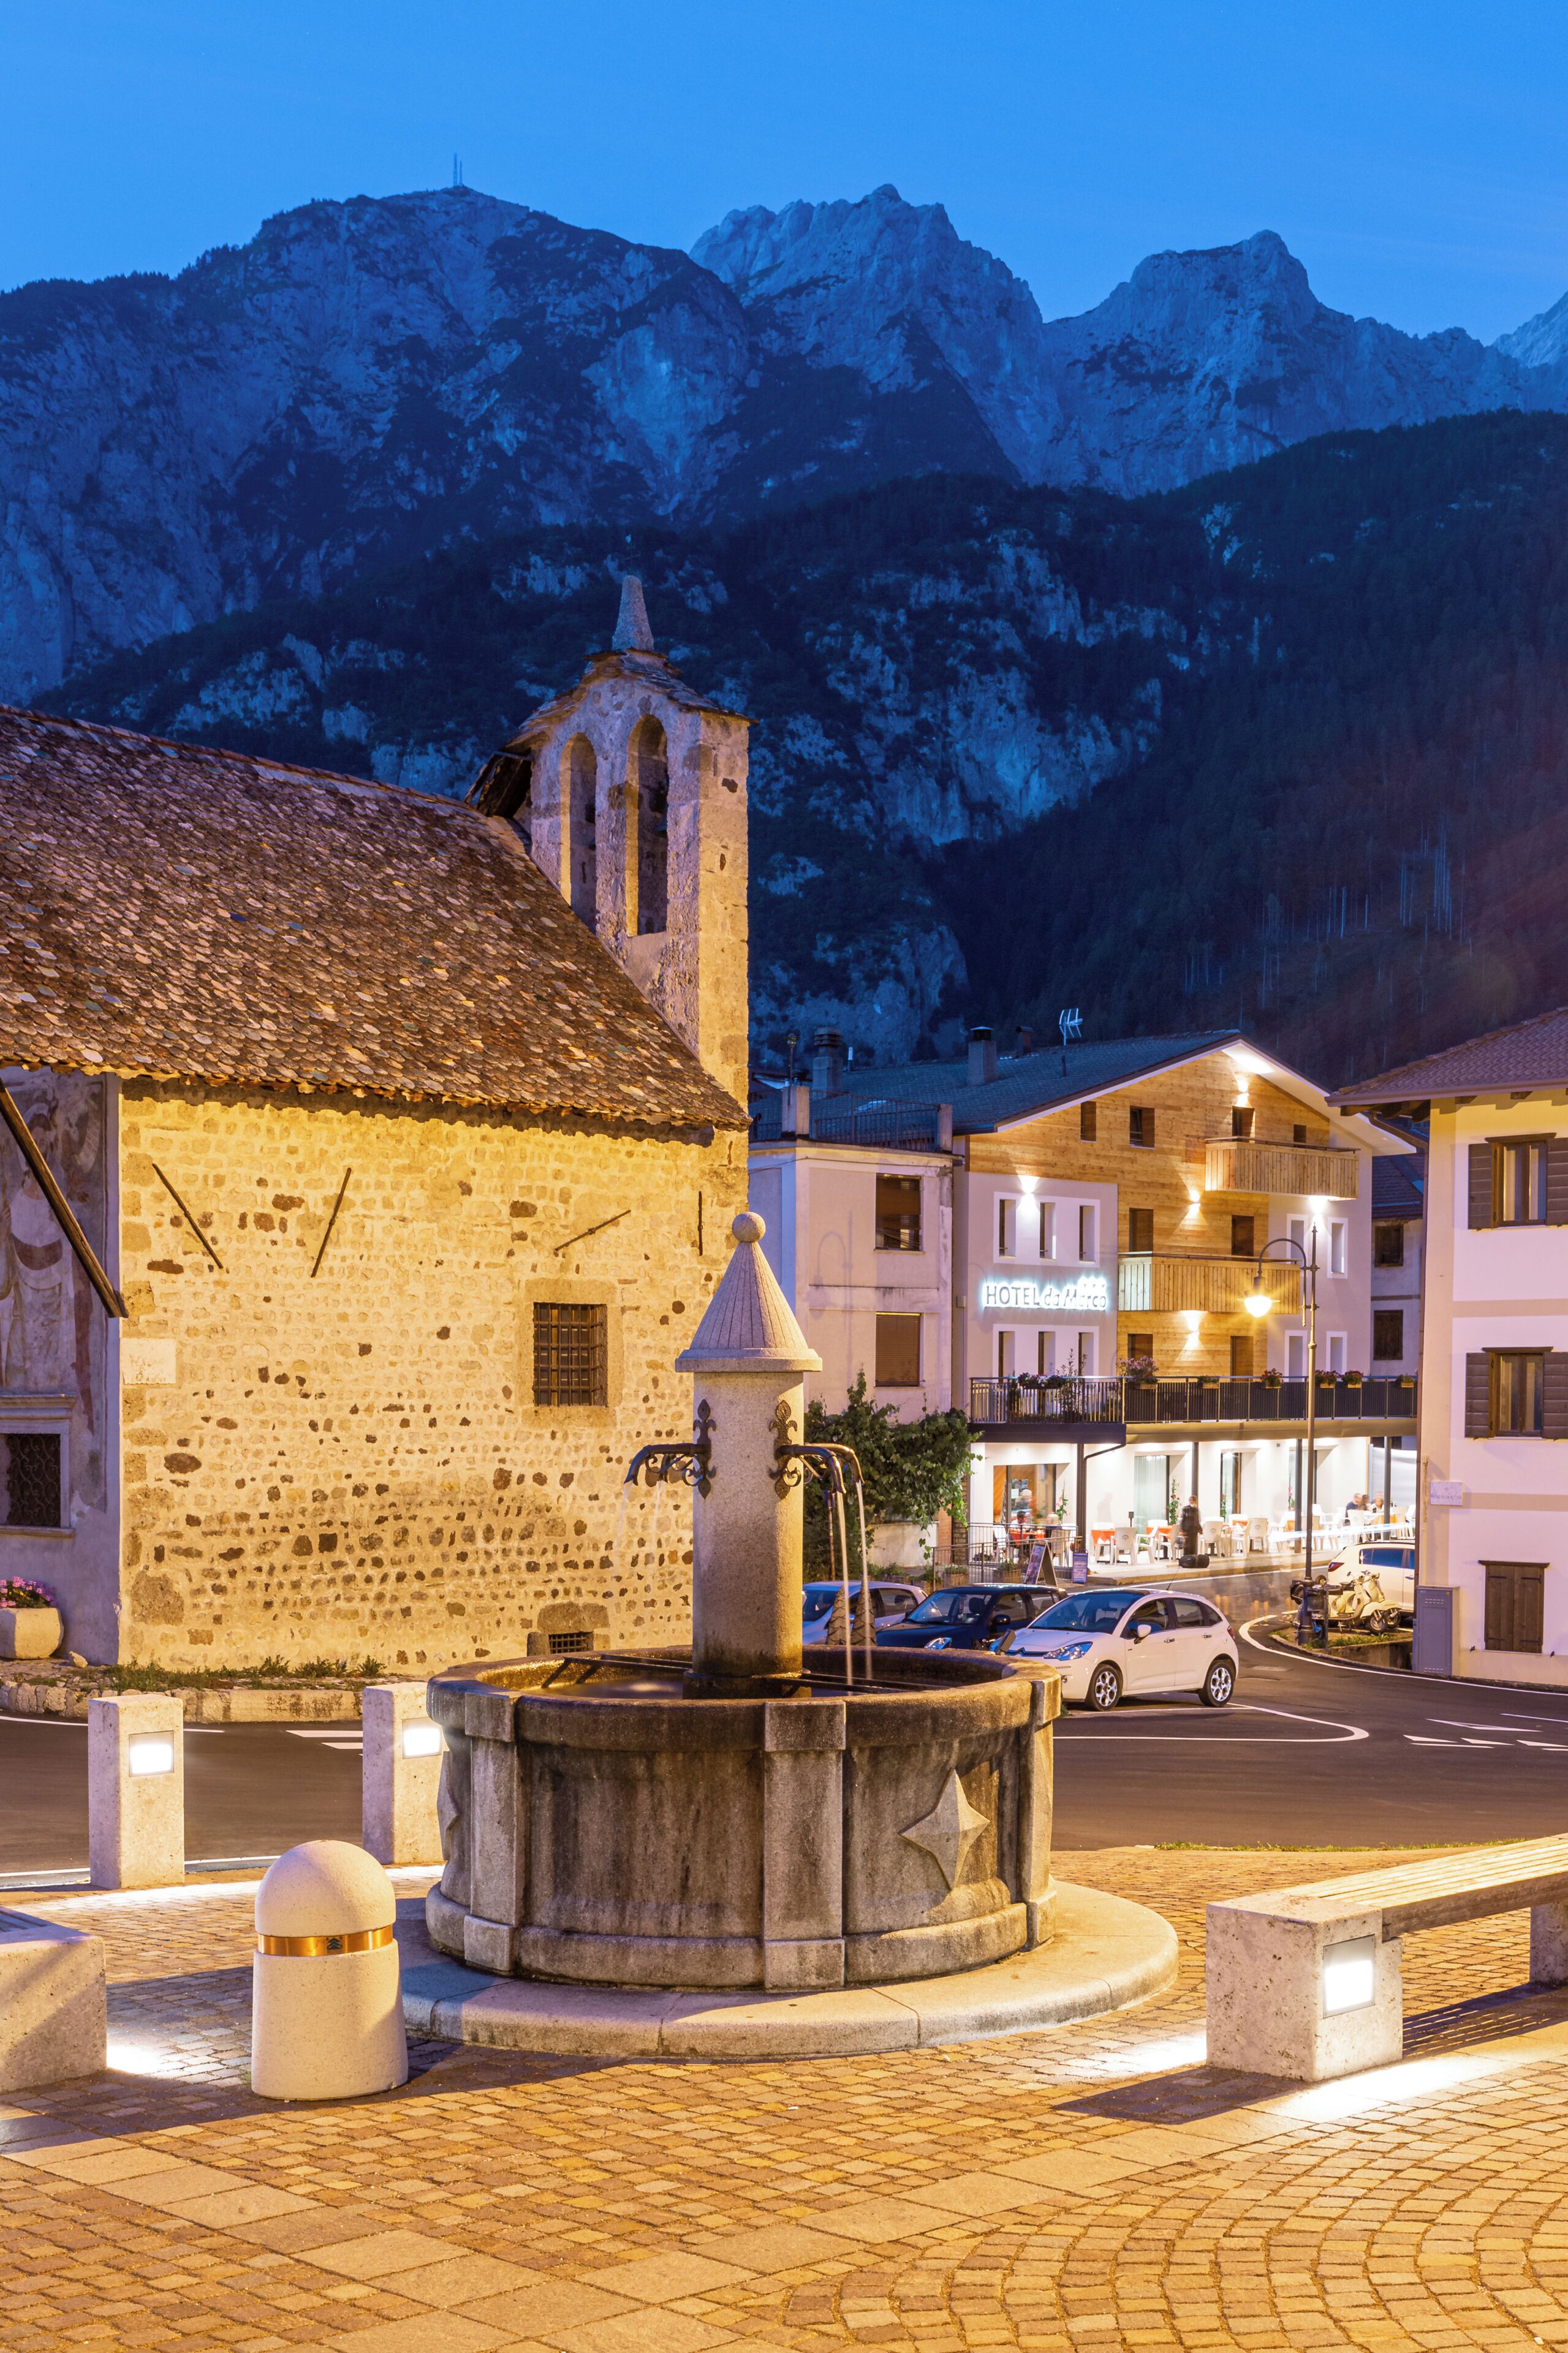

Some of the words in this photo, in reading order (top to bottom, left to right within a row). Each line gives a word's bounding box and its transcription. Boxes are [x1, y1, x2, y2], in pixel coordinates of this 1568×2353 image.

[986, 1286, 1040, 1306] HOTEL
[1044, 1287, 1060, 1306] da
[1063, 1289, 1107, 1308] Marco
